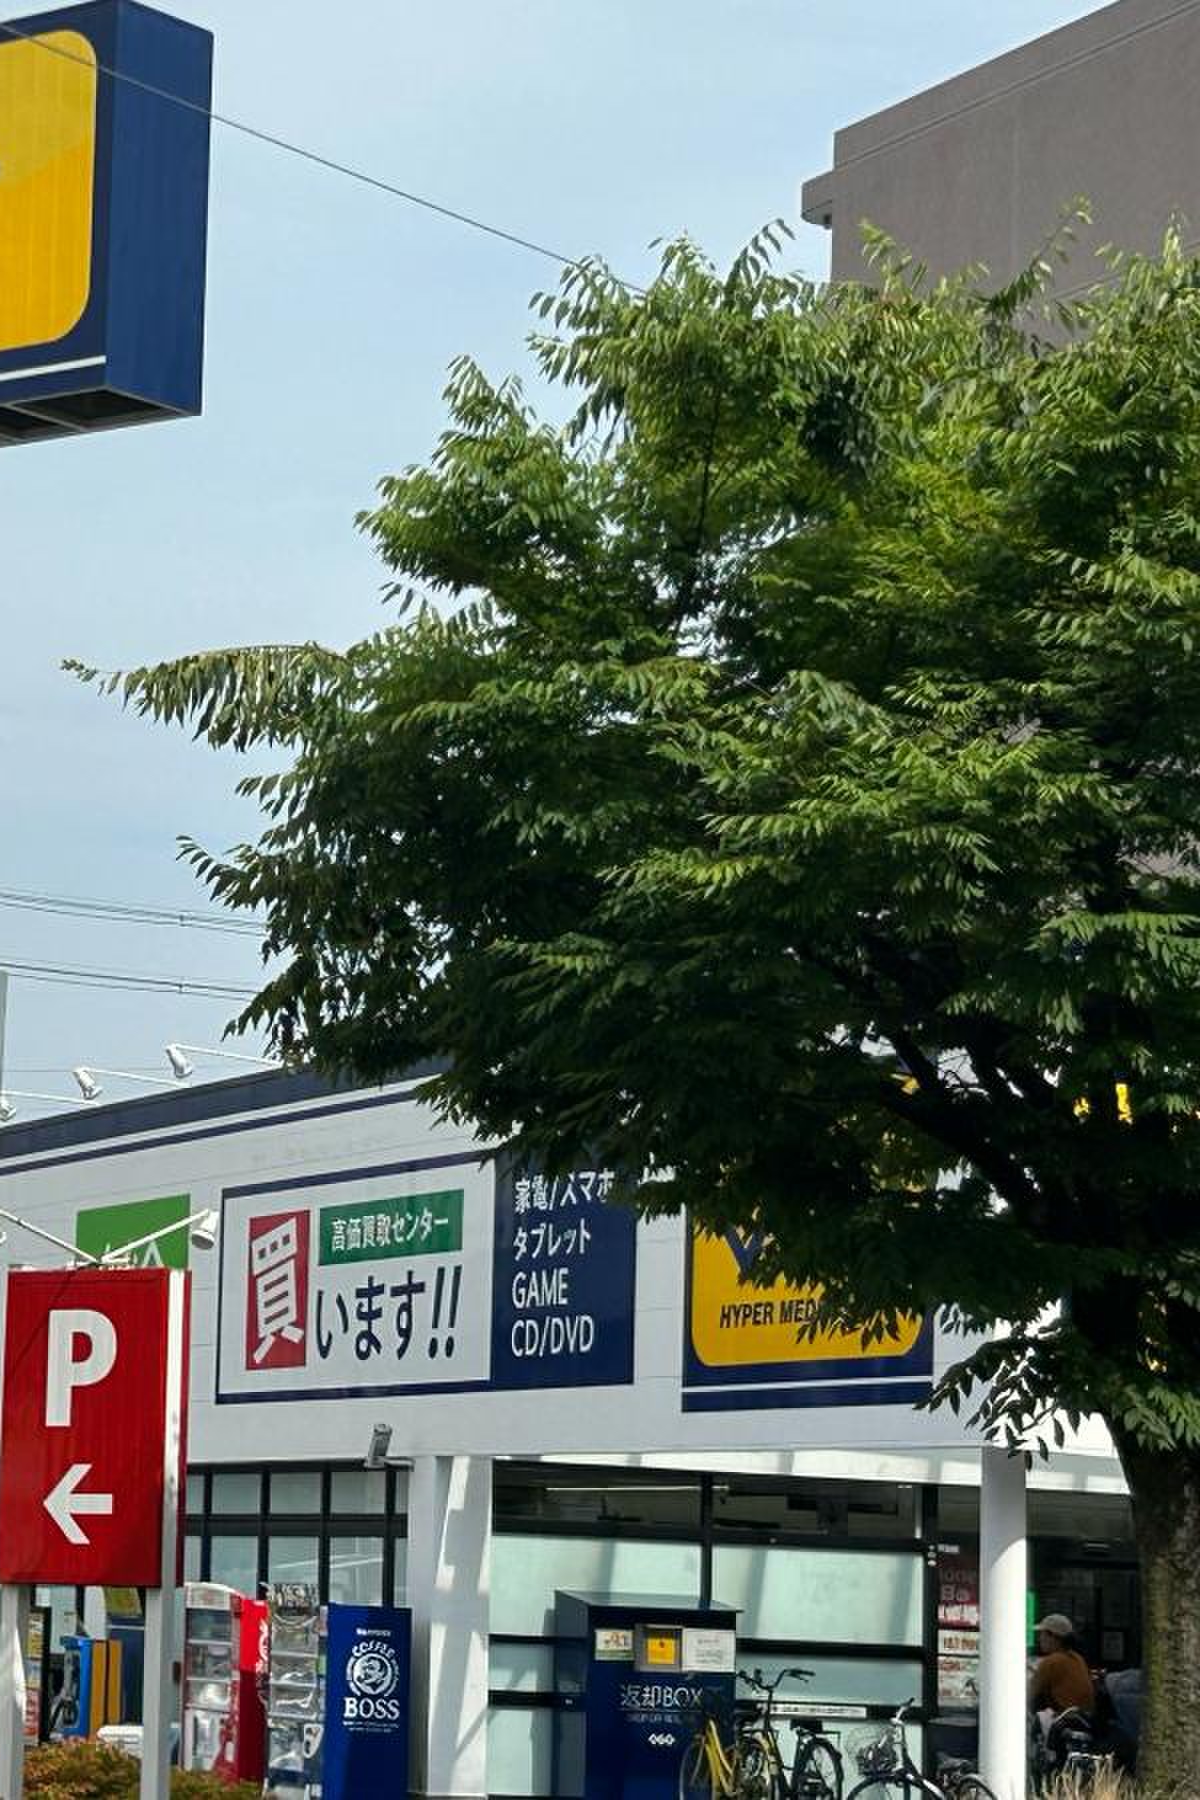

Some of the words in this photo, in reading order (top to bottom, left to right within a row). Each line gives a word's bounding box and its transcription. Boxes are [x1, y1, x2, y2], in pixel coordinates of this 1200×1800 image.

[331, 1206, 449, 1252] 高価買取センター
[513, 1218, 591, 1261] タブレット
[512, 1267, 569, 1310] GAME
[511, 1314, 594, 1358] CD/DVD
[720, 1301, 774, 1329] HYPER
[45, 1309, 118, 1427] P
[343, 1697, 400, 1720] BOSS
